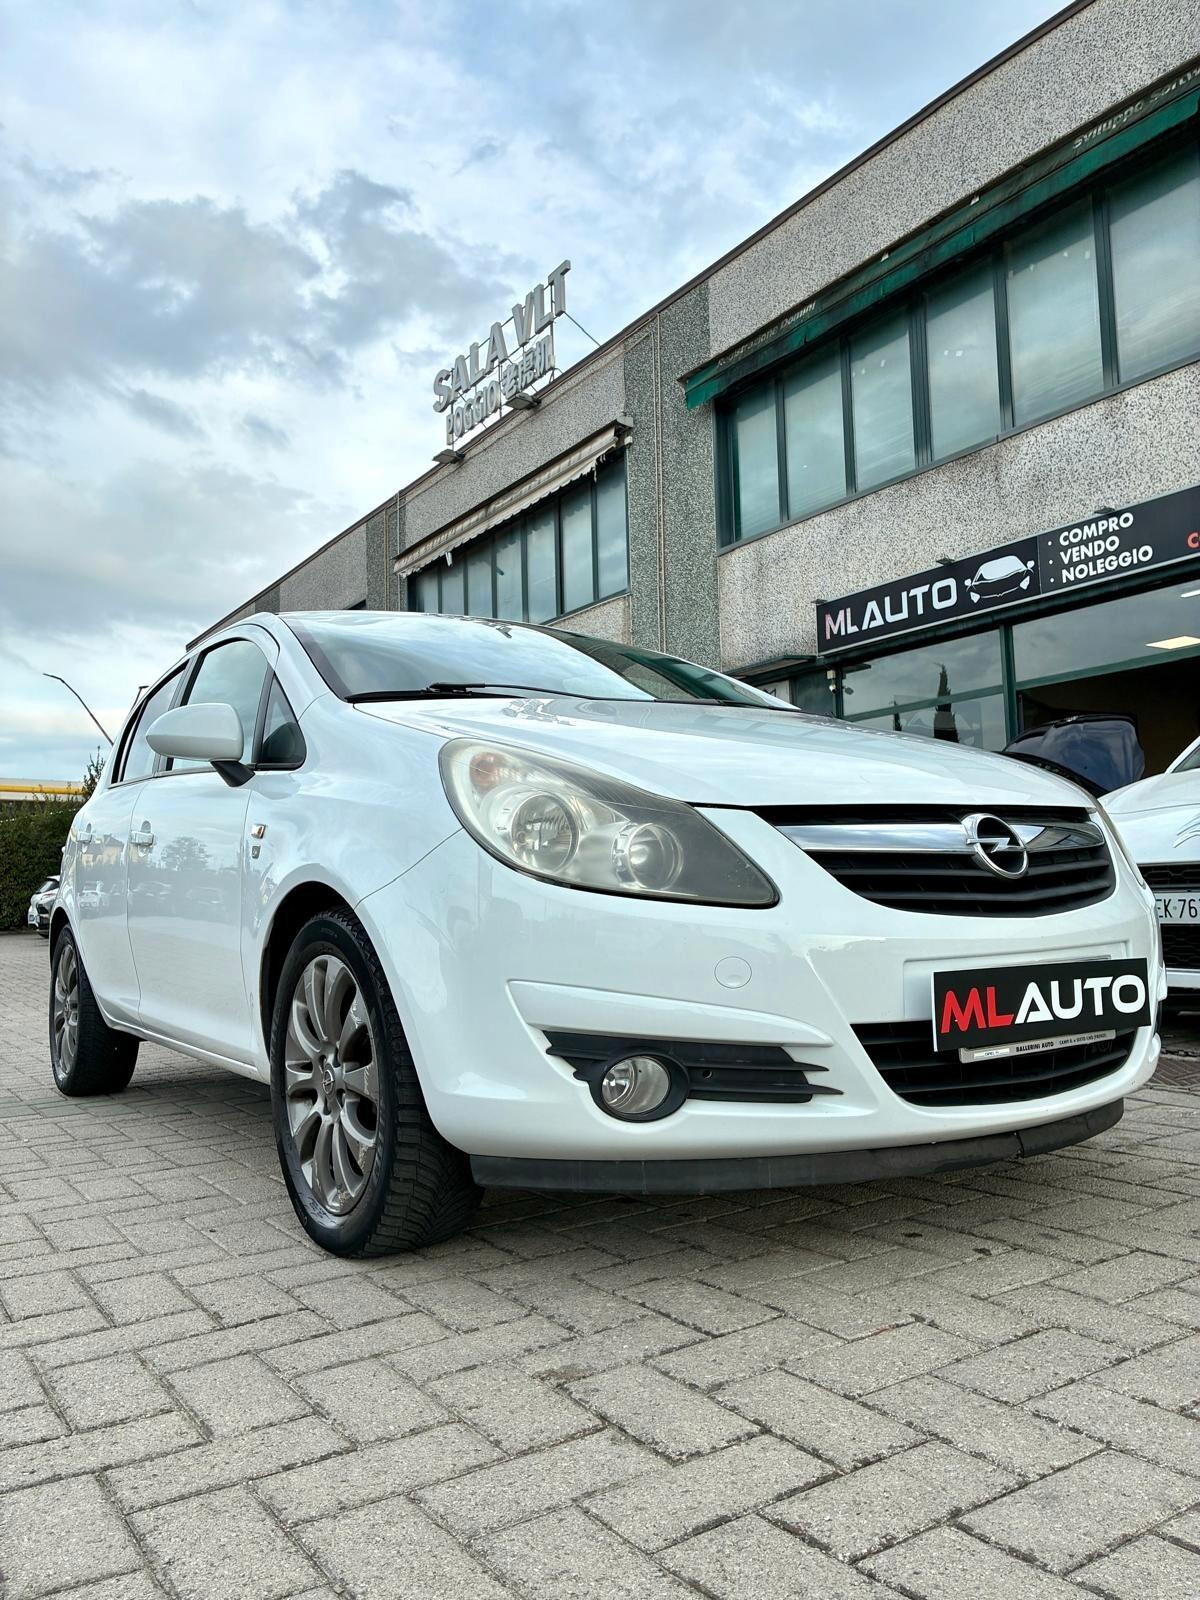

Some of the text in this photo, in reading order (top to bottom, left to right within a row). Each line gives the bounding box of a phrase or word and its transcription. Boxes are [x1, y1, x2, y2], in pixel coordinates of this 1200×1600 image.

[433, 259, 571, 413] SALA VLT
[446, 380, 501, 446] POGGIO
[1059, 512, 1134, 547] COMPRO
[1060, 535, 1120, 565] VENDO
[1061, 545, 1153, 583] NOLEGGIO
[1178, 898, 1200, 918] 76
[1042, 1041, 1054, 1049] AUTO
